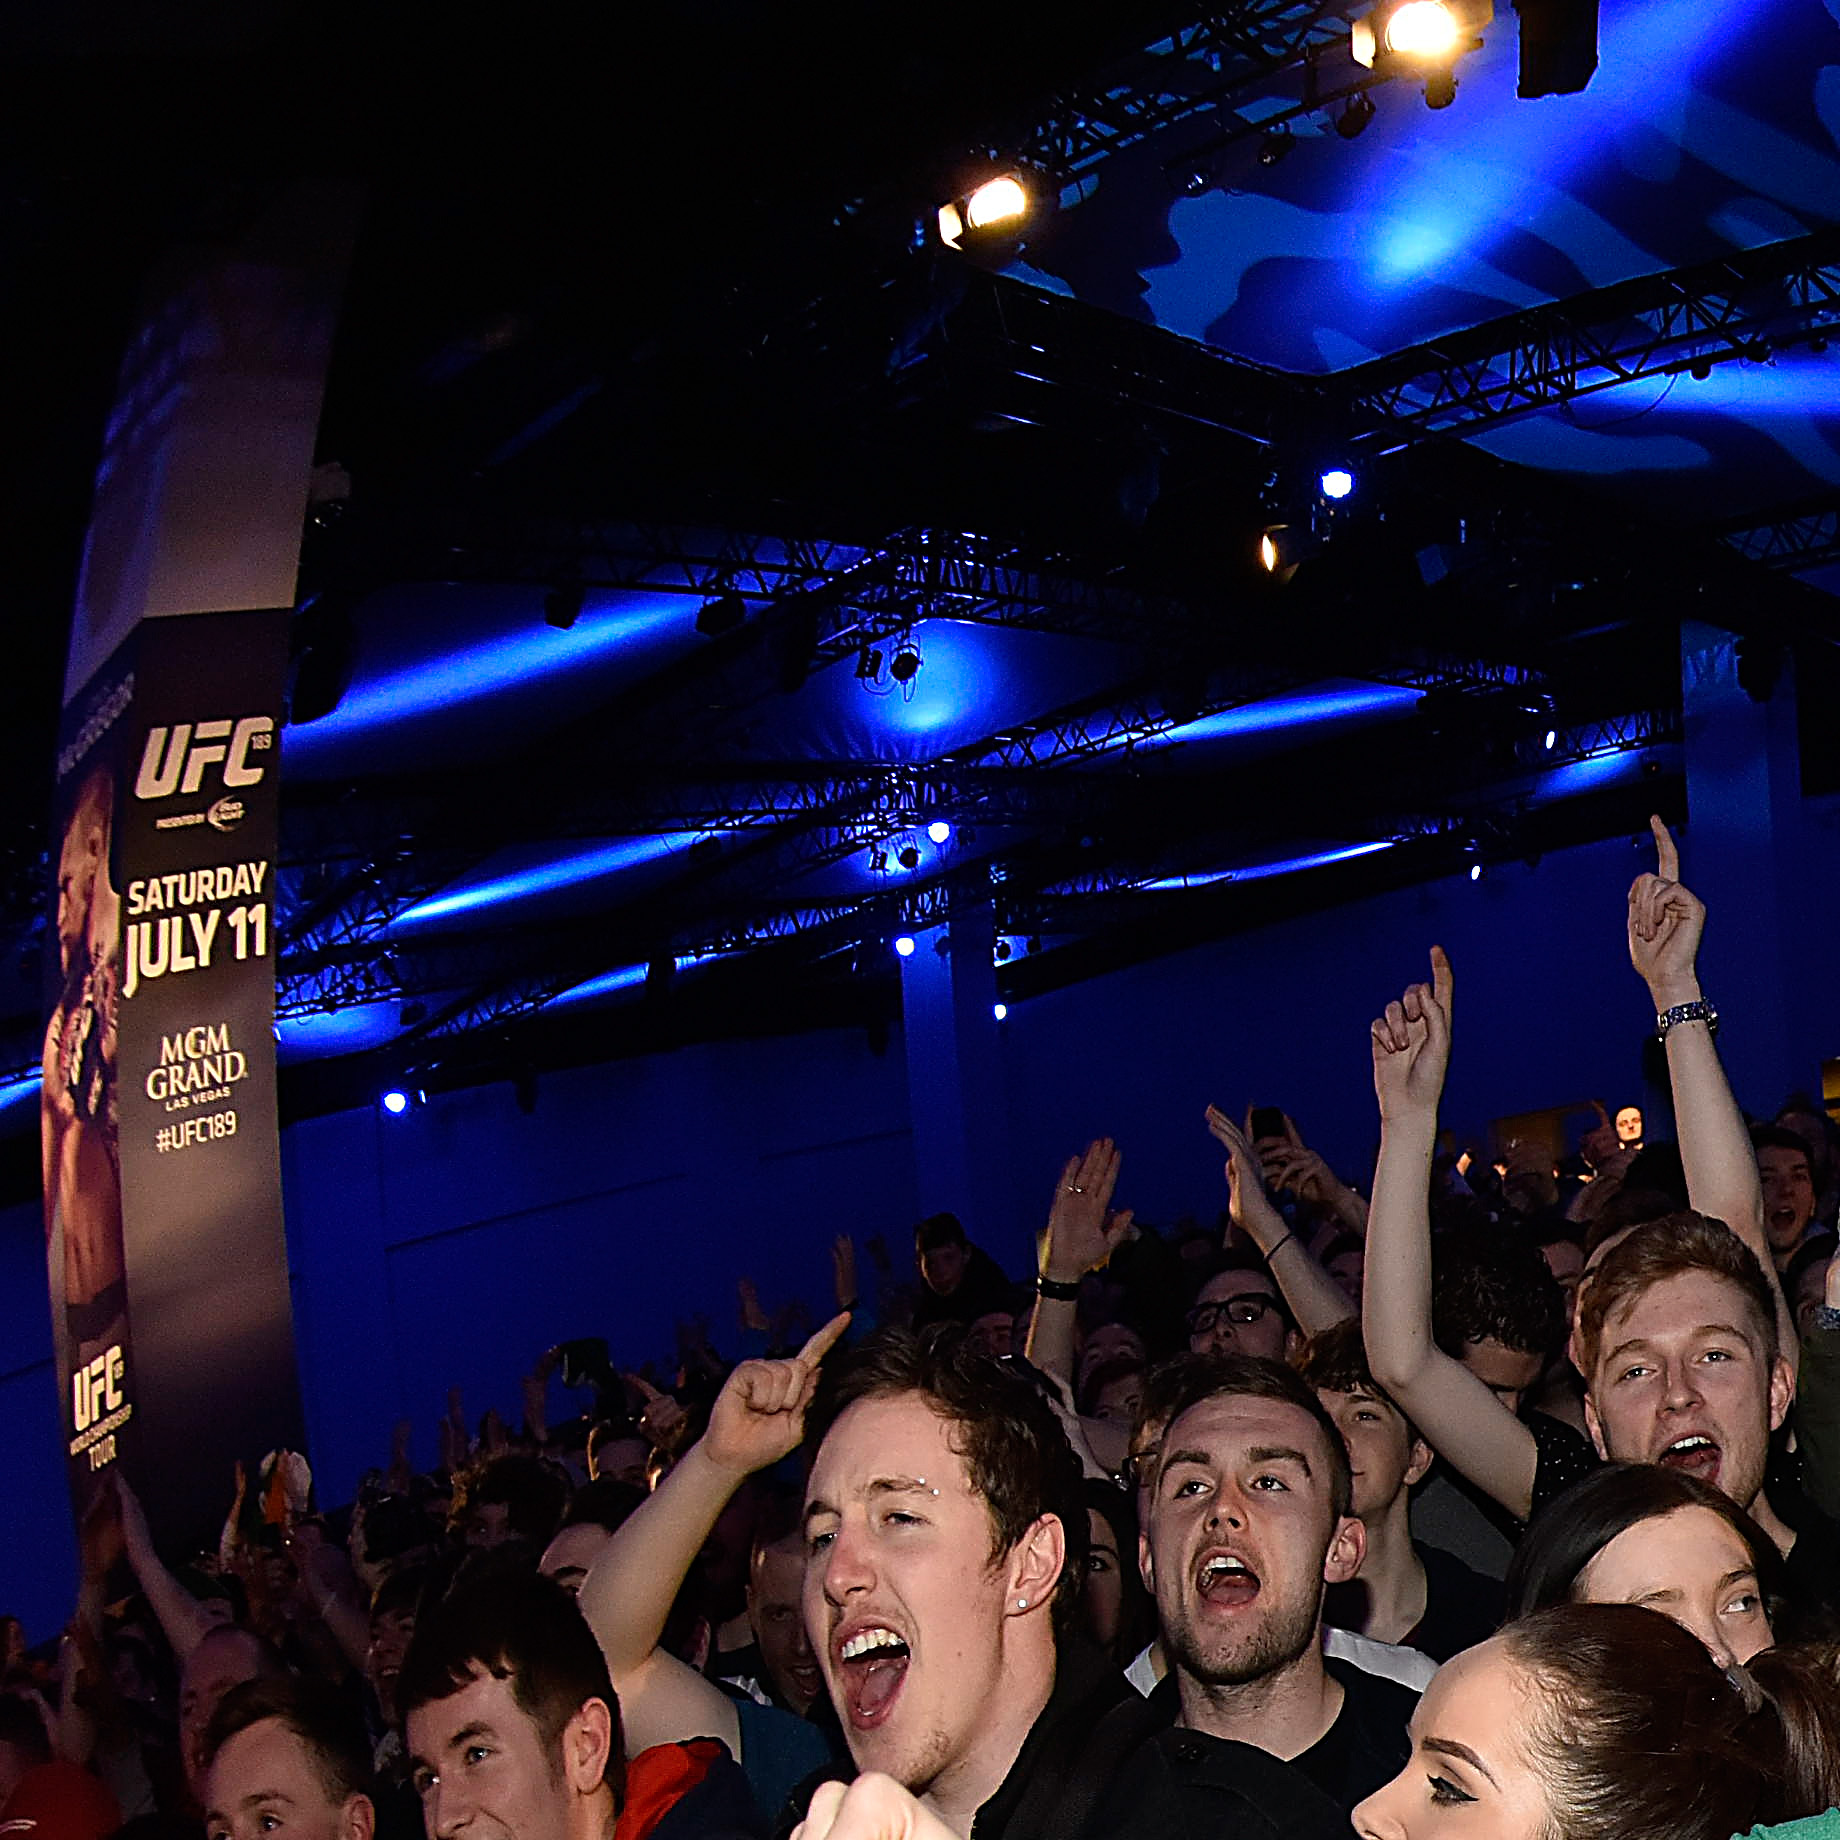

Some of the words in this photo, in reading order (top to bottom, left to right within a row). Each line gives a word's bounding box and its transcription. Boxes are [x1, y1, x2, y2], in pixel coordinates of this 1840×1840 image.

[135, 716, 275, 800] UFC
[127, 860, 268, 915] SATURDAY
[122, 908, 221, 999] JULY
[228, 903, 267, 961] 11
[160, 1023, 230, 1067] MGM
[146, 1050, 247, 1101] GRAND
[165, 1097, 190, 1112] LAS
[192, 1086, 232, 1107] VEGAS
[156, 1110, 237, 1153] #UFC189
[73, 1345, 123, 1432] UFC
